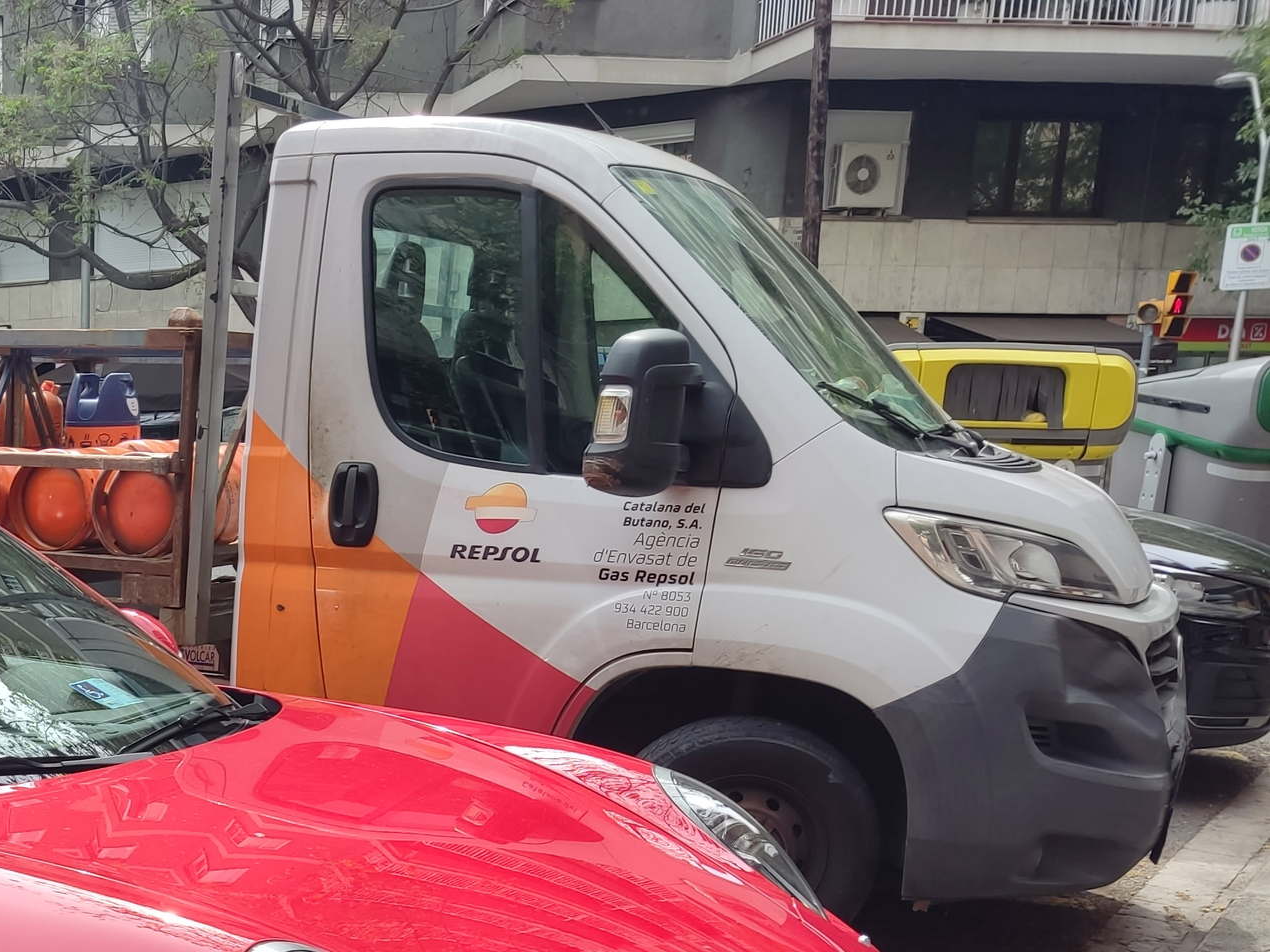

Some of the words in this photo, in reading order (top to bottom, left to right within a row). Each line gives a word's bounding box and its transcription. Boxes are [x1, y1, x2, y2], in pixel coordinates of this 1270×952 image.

[623, 501, 681, 513] Catalana
[684, 503, 706, 514] del
[622, 516, 672, 530] Butano,
[676, 518, 703, 530] S.A.
[633, 531, 701, 550] Agència
[449, 544, 541, 563] REPSOL
[593, 548, 673, 567] d'Envasat
[676, 552, 698, 568] de
[598, 568, 630, 582] Gas
[634, 569, 696, 587] Repsol
[660, 590, 692, 602] 8053
[614, 602, 636, 614] 934
[639, 604, 662, 616] 422
[665, 605, 689, 618] 900
[626, 618, 687, 633] Barcelona
